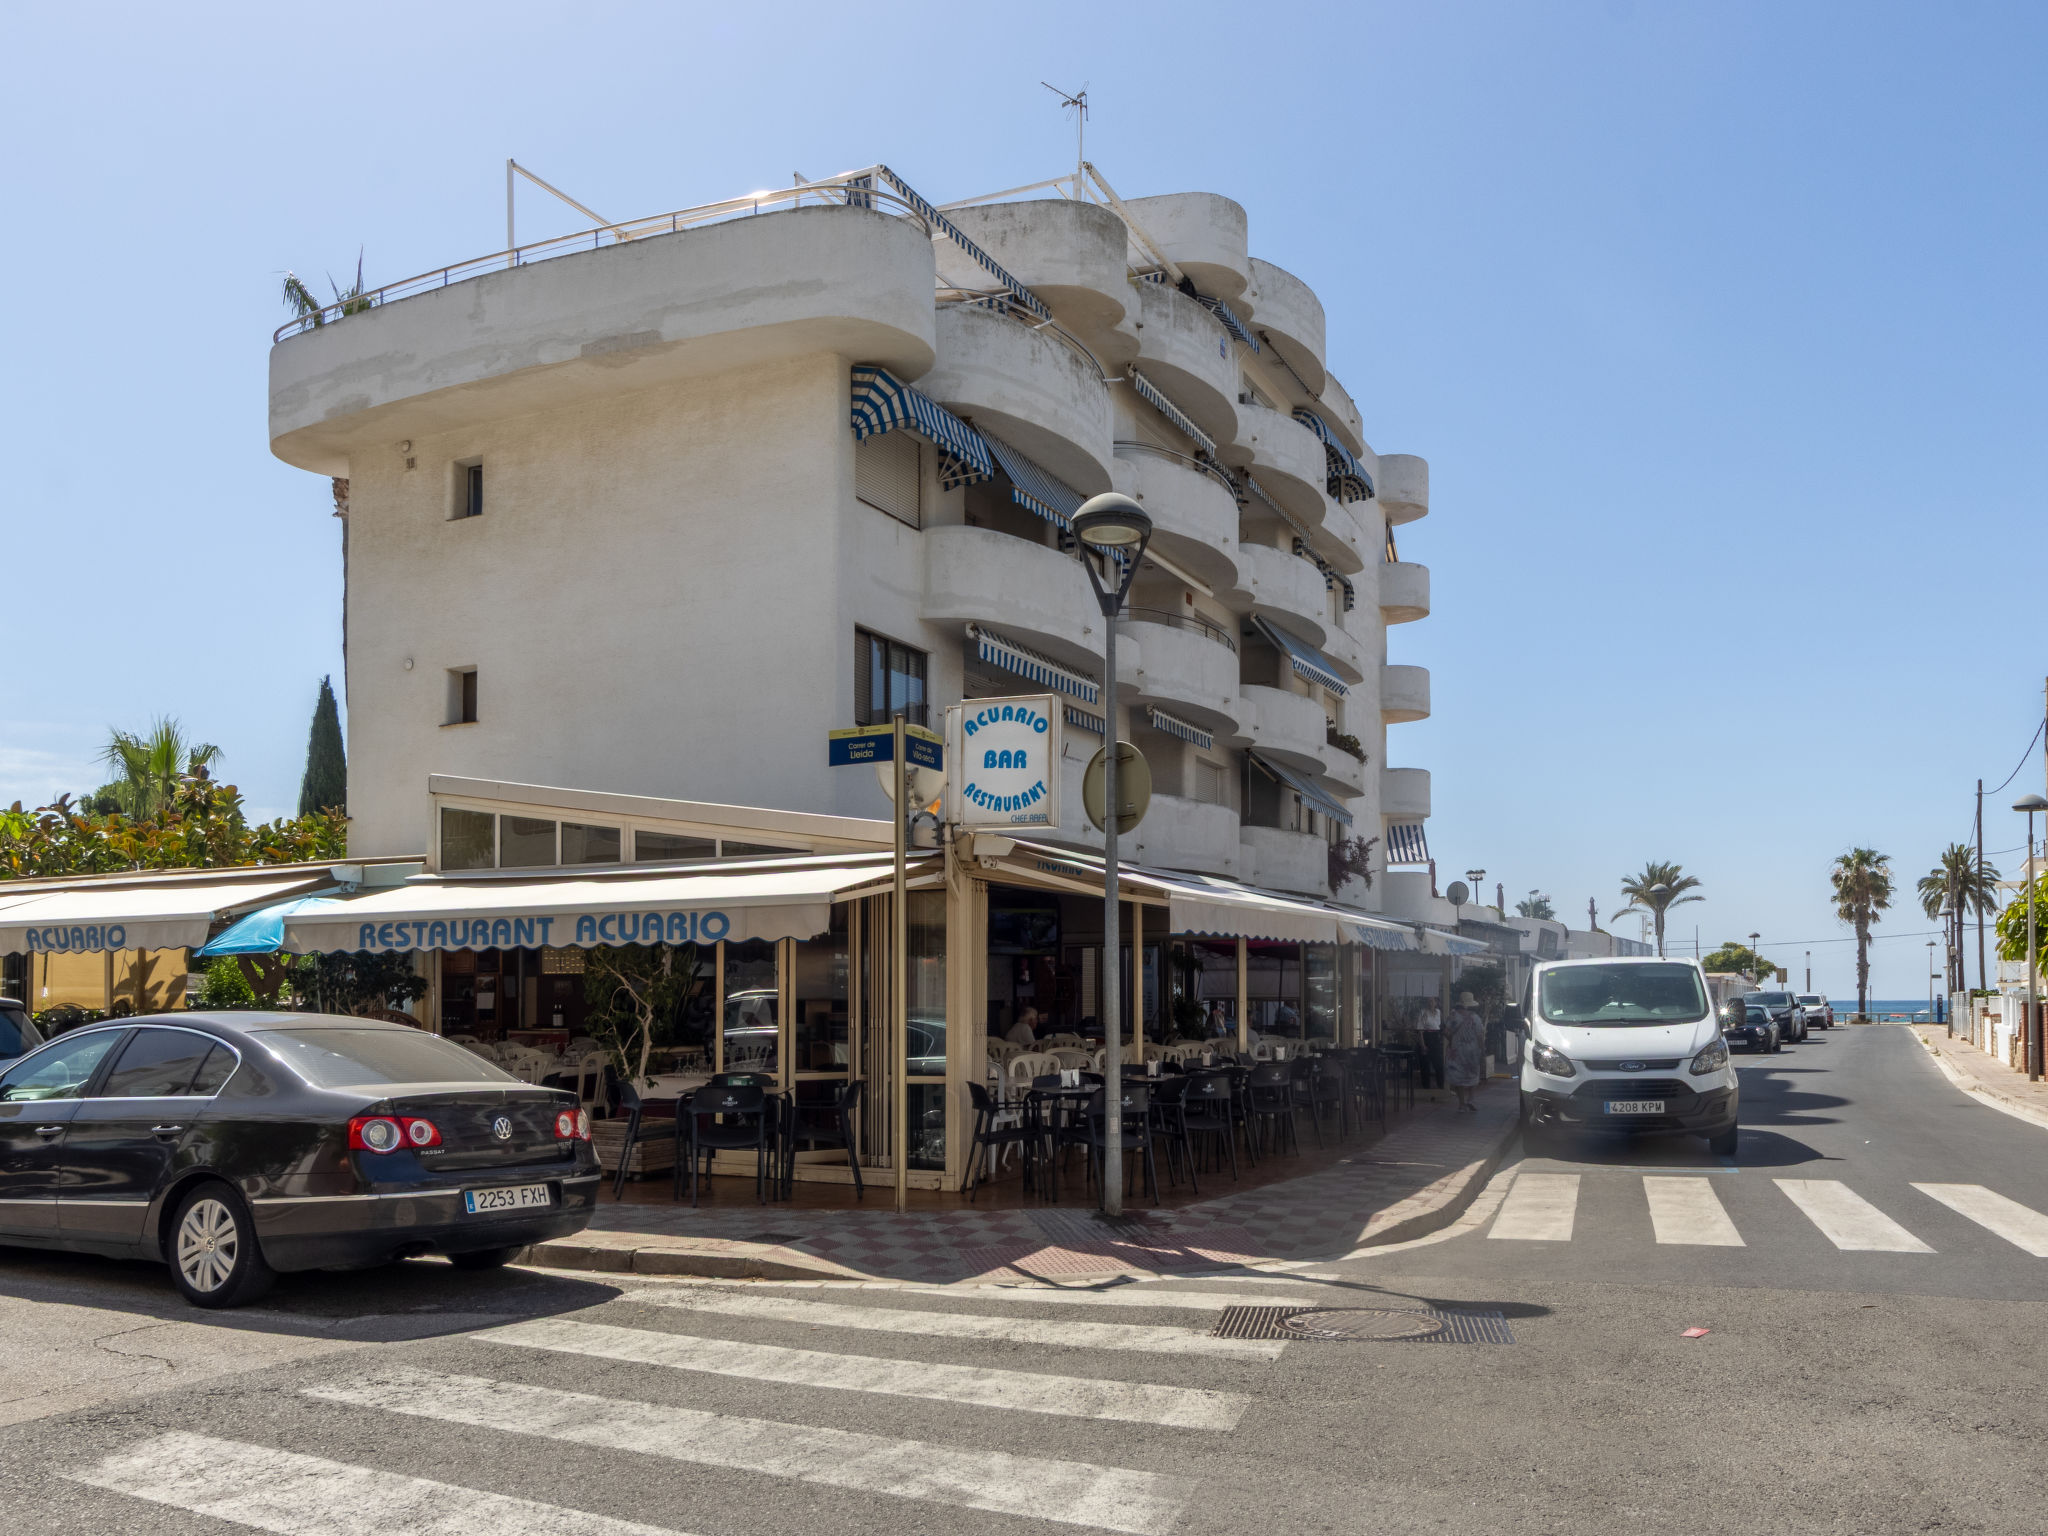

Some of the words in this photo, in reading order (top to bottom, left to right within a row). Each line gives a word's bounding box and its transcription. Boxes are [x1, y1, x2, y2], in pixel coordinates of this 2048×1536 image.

[964, 705, 1048, 736] ACUARIO
[850, 750, 874, 759] Lleida
[983, 750, 1027, 768] BAR
[963, 780, 1047, 812] RESTAURANT
[1011, 814, 1028, 823] CHEF
[26, 924, 126, 949] ACUARIO
[359, 917, 554, 948] RESTAURANT
[575, 911, 730, 942] ACUARIO
[1612, 1103, 1638, 1113] 4208
[1642, 1103, 1662, 1113] KPM
[478, 1190, 515, 1209] 2253
[521, 1186, 547, 1205] FXH
